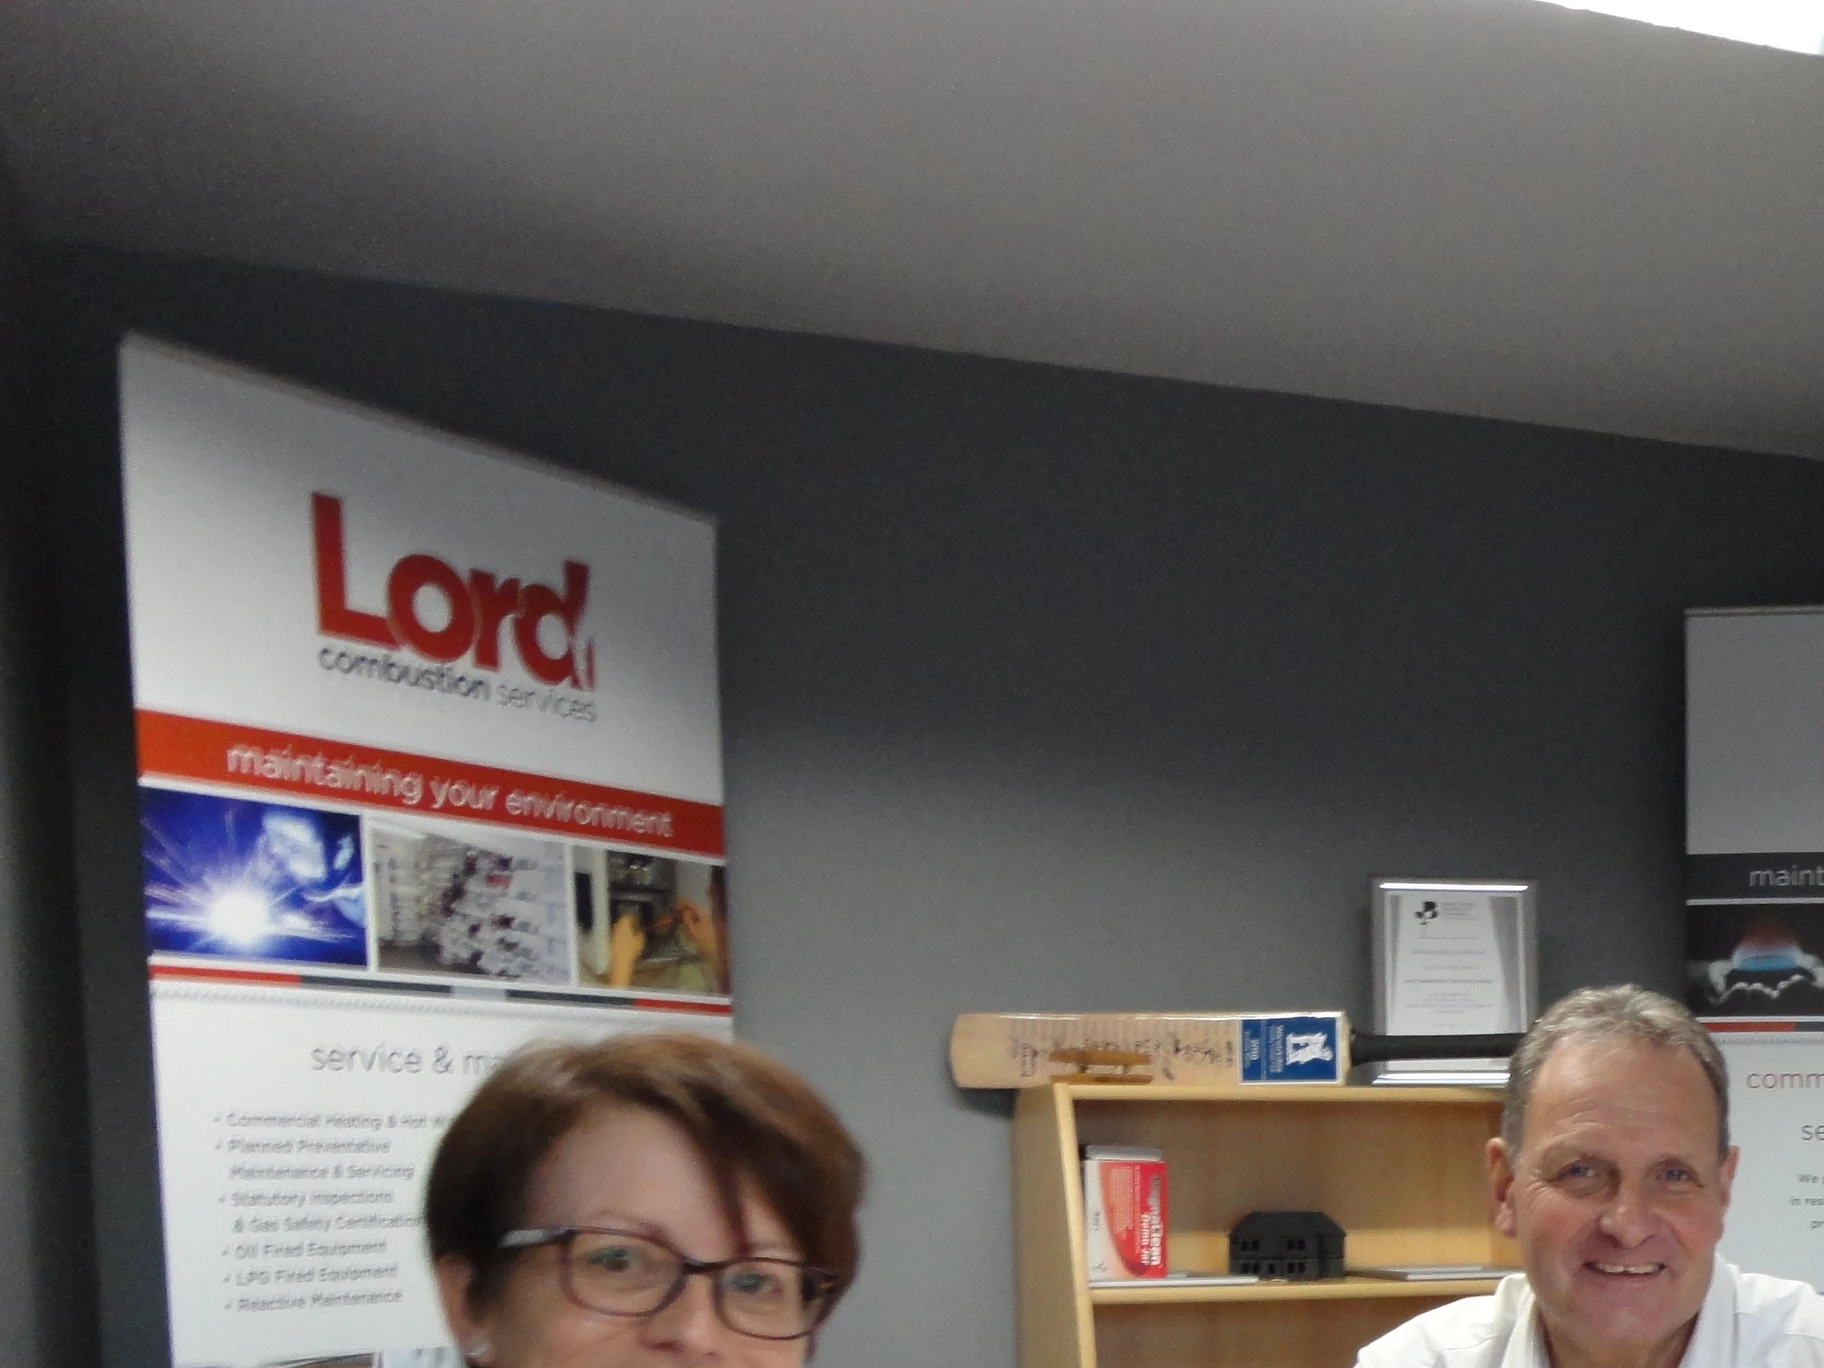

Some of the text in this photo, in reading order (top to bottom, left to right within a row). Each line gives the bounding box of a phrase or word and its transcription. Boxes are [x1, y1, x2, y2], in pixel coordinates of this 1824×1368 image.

[311, 492, 595, 690] Lord
[318, 645, 597, 723] combustion services
[226, 742, 674, 838] maintaining your environment
[310, 1041, 422, 1075] service
[431, 1046, 454, 1075] &
[225, 1112, 320, 1128] Commercial
[227, 1138, 294, 1154] Planned
[230, 1164, 329, 1181] Maintenance
[346, 1164, 415, 1181] Servicing
[1797, 1174, 1818, 1184] We
[1790, 1196, 1801, 1206] in
[306, 1242, 387, 1258] Equipment
[318, 1266, 398, 1282] Equipment
[310, 1291, 403, 1308] Maintenance
